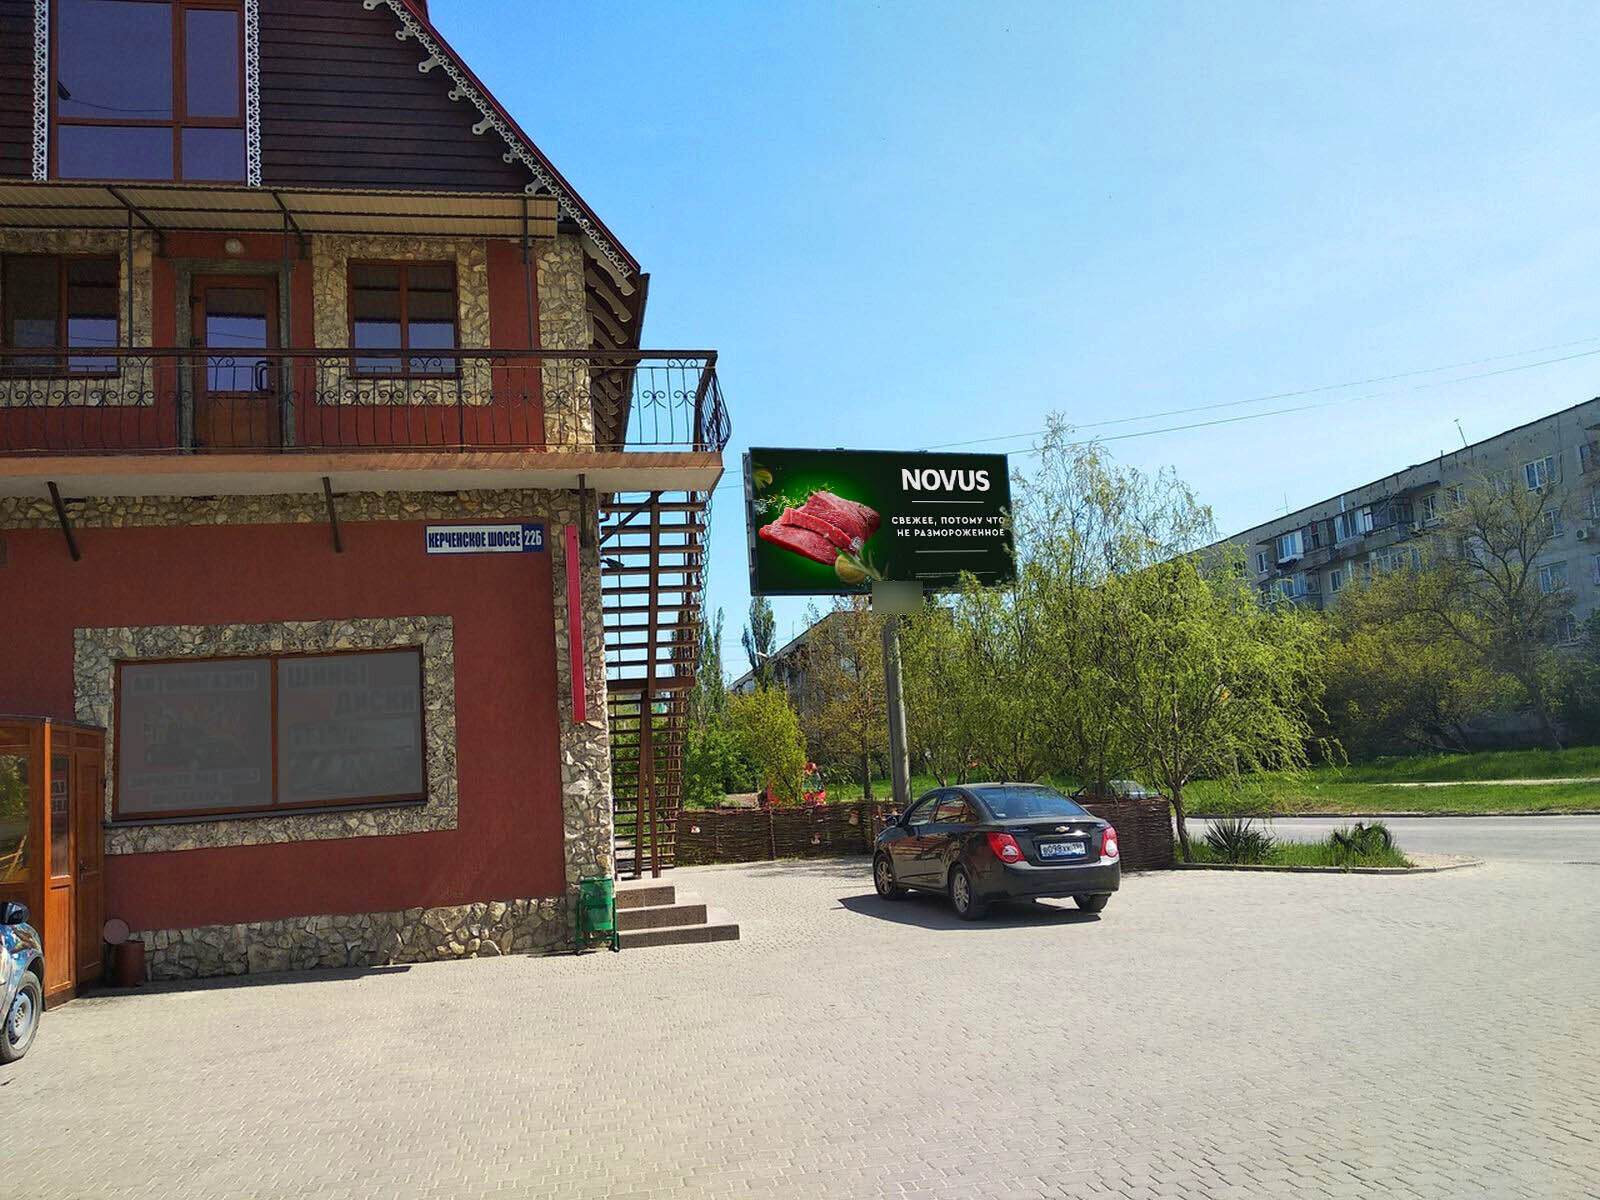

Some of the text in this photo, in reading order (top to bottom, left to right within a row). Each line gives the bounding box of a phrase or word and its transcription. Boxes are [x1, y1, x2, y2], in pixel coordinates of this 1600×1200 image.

[901, 468, 991, 492] NOVUS
[891, 516, 937, 527] СВЕЖЕЕ,
[941, 516, 983, 525] ПОТОМУ
[428, 531, 486, 548] КЕРЧЕНСКОЕ
[487, 531, 521, 547] ШОССЕ
[897, 528, 1005, 537] НЕ РАЗМОРОЖЕННОЕ
